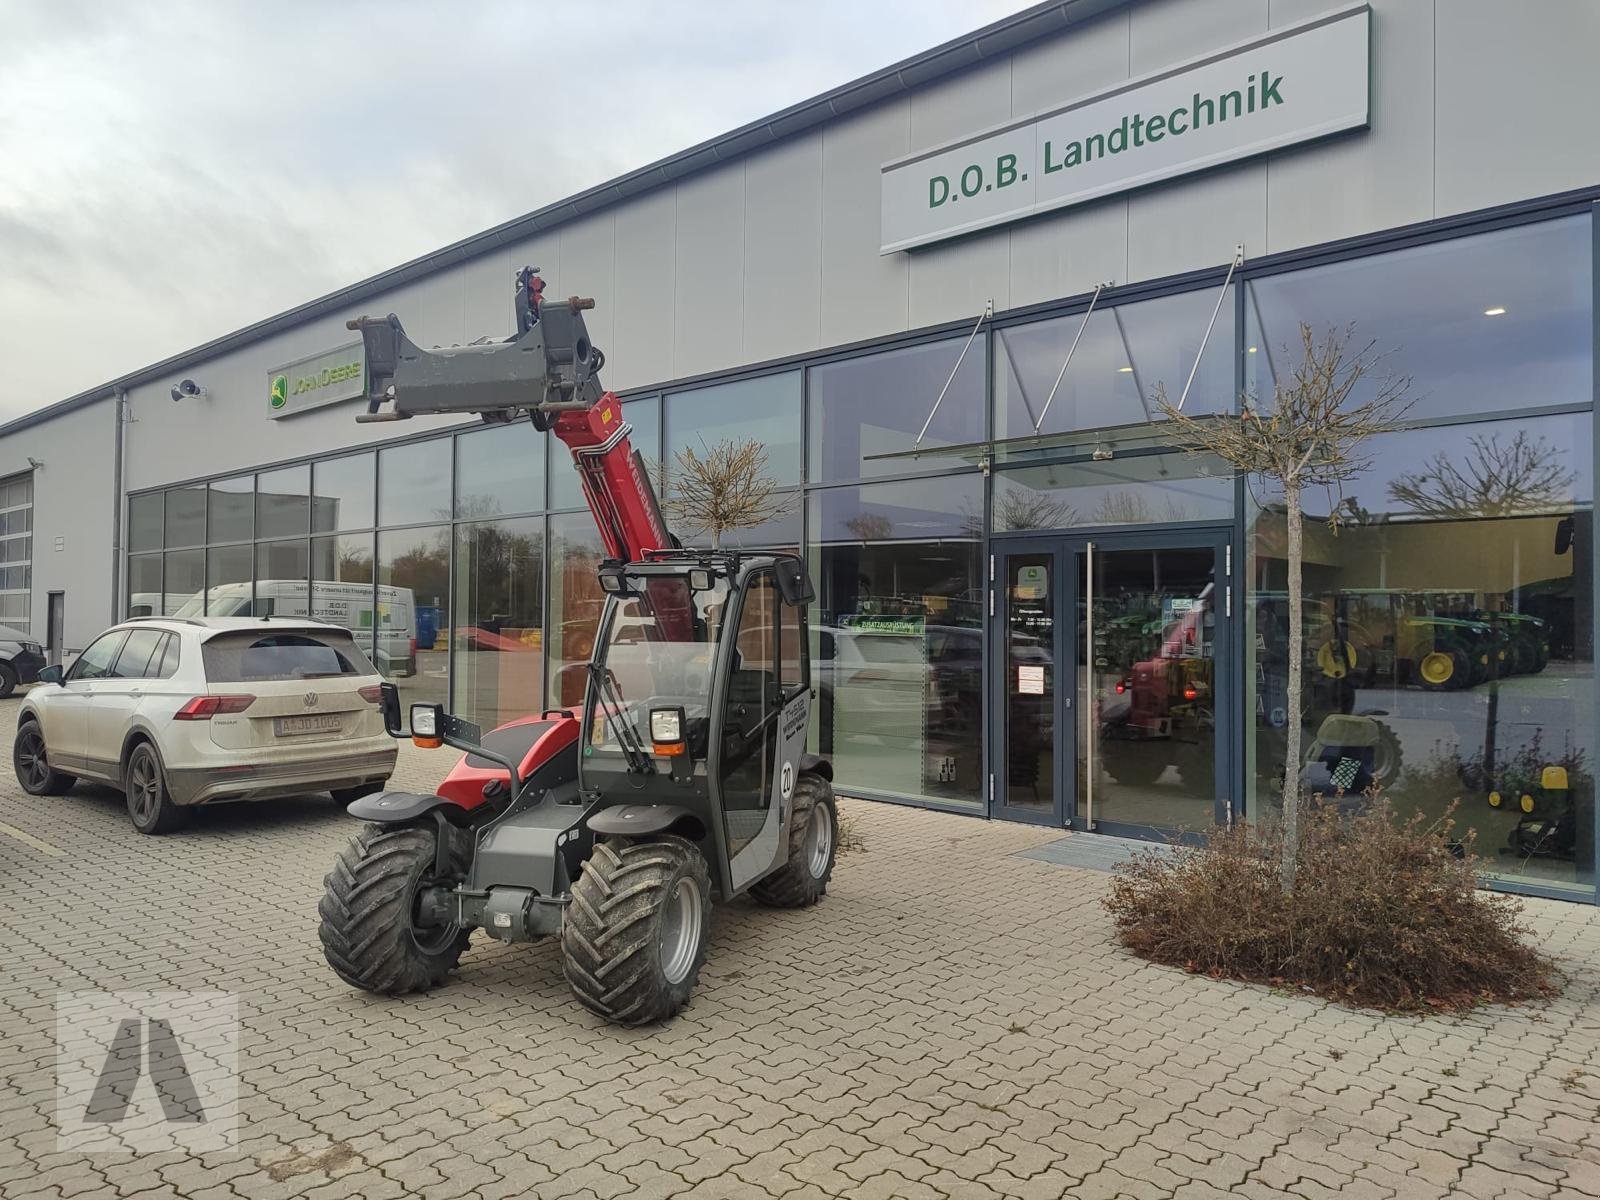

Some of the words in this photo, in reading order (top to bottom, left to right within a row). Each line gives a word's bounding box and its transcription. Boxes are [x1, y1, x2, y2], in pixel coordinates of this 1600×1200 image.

[929, 153, 1028, 209] D.O.B.
[1044, 71, 1285, 174] Landtechnik
[626, 449, 663, 549] WEIDEMANN
[783, 767, 791, 793] 20
